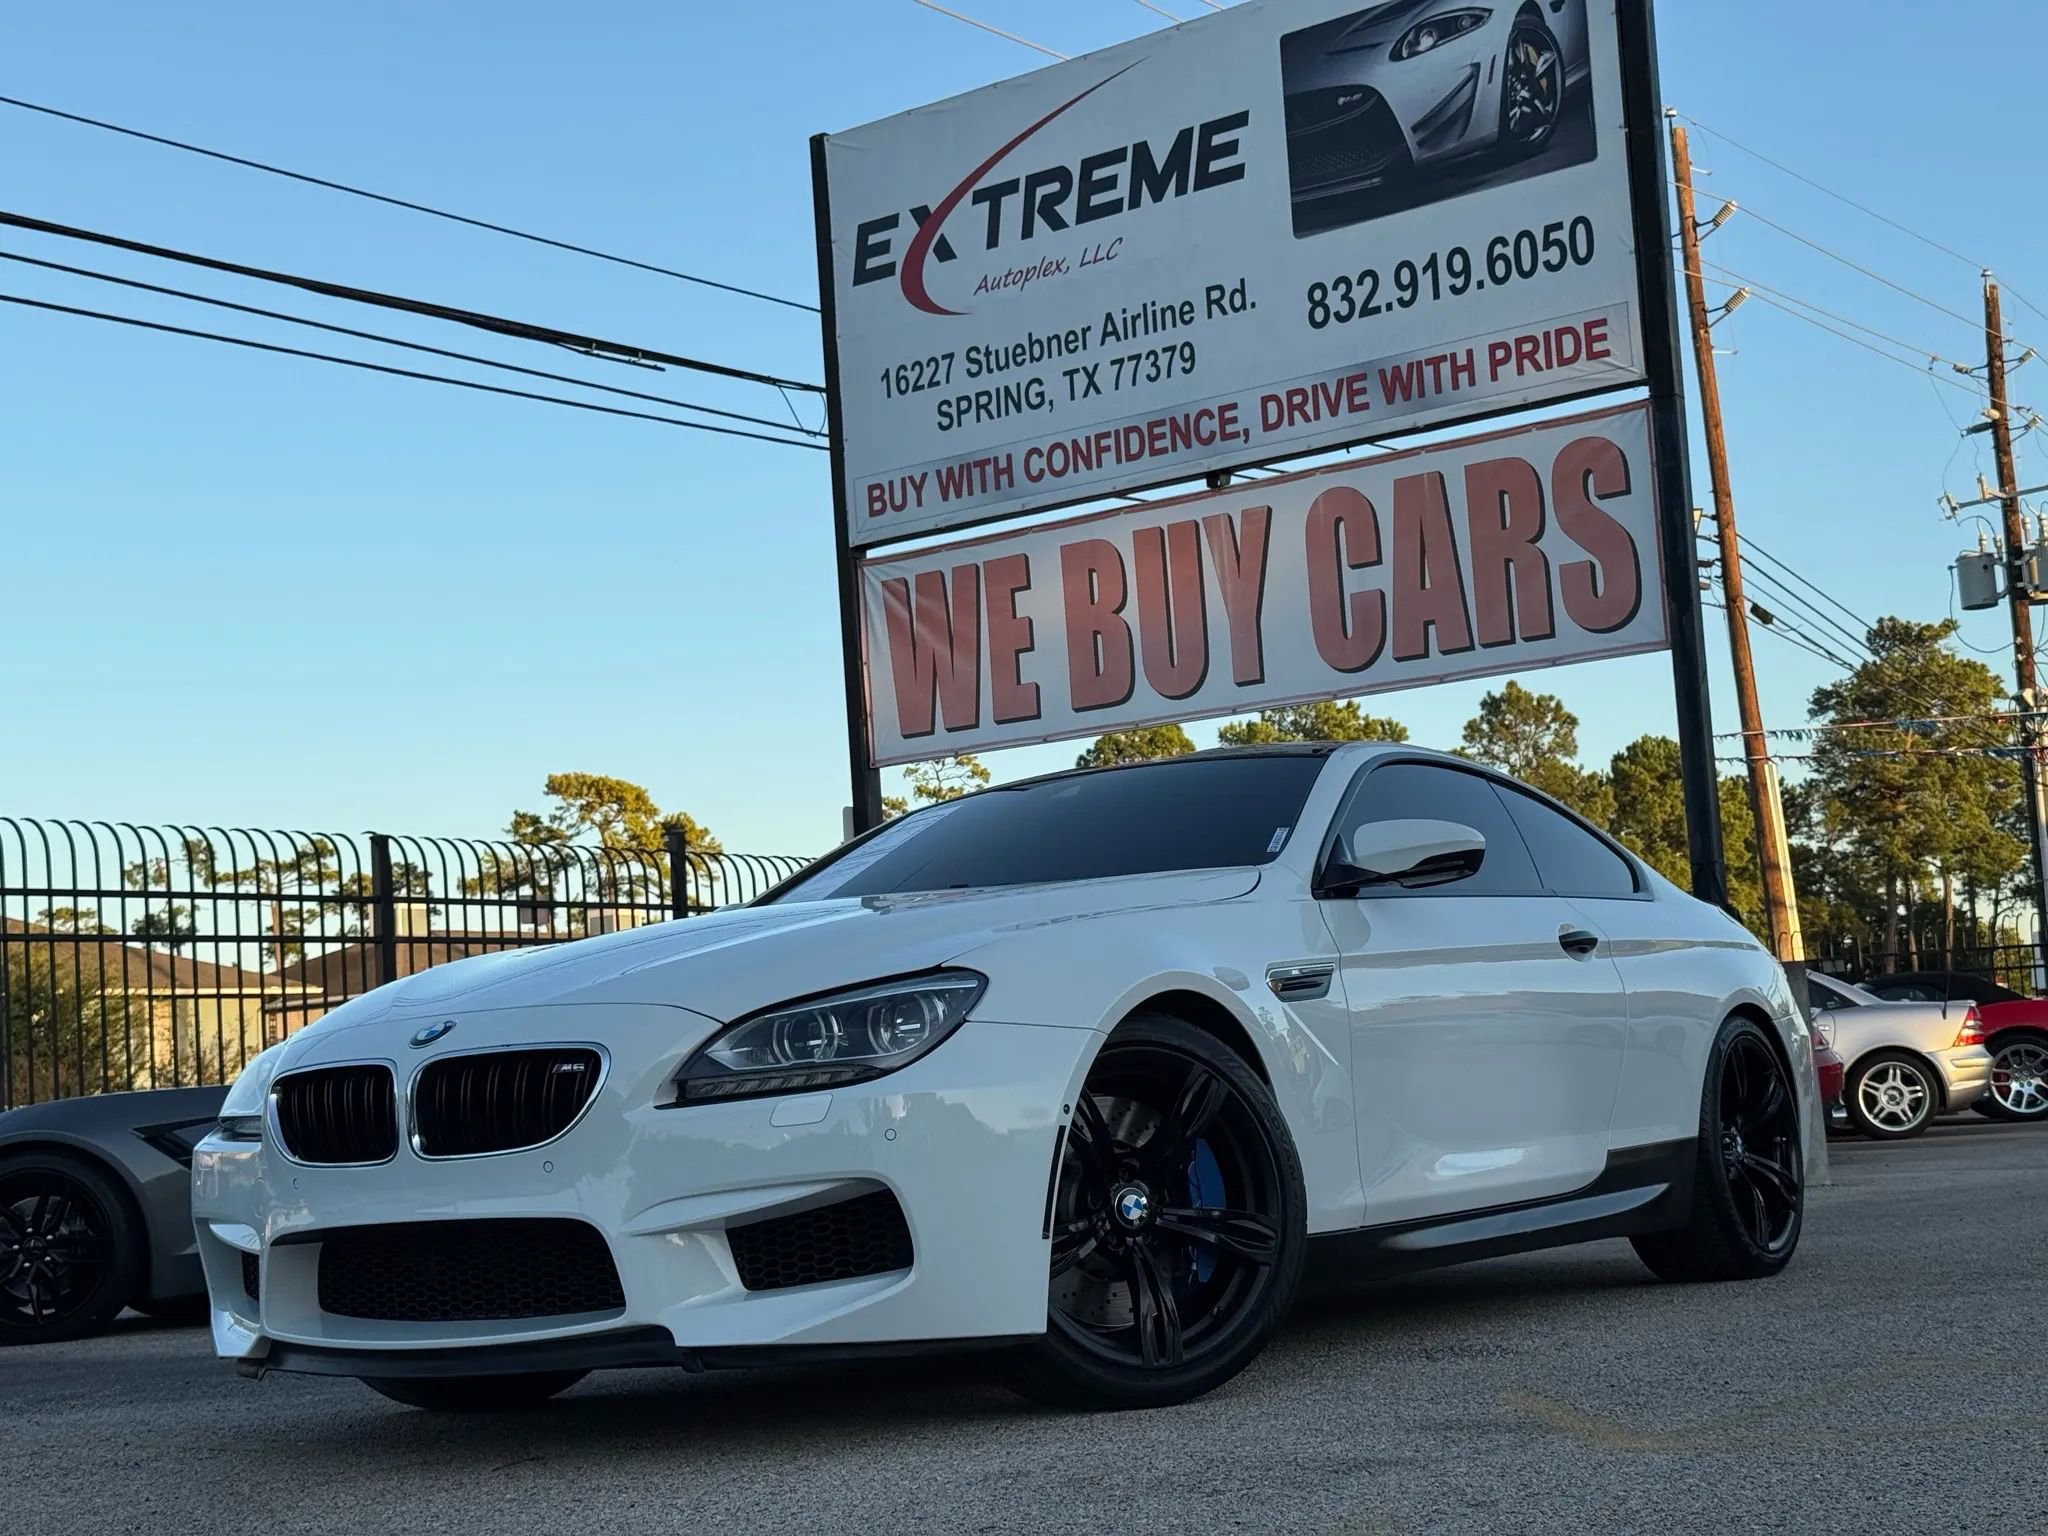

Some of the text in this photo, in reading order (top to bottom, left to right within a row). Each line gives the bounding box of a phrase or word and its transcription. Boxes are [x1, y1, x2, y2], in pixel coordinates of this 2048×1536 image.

[853, 110, 1249, 288] EXTREME
[974, 236, 1124, 296] Autoplex, LLC
[1307, 216, 1595, 330] 832.919.6050
[881, 278, 1256, 398] 16227 Stuebner Airline Rd.
[937, 341, 1196, 431] SPRING, TX 77379
[867, 318, 1611, 518] BUY WITH CONFIDENCE, DRIVE WITH PRIDE
[881, 436, 1642, 738] WE BUY CARS
